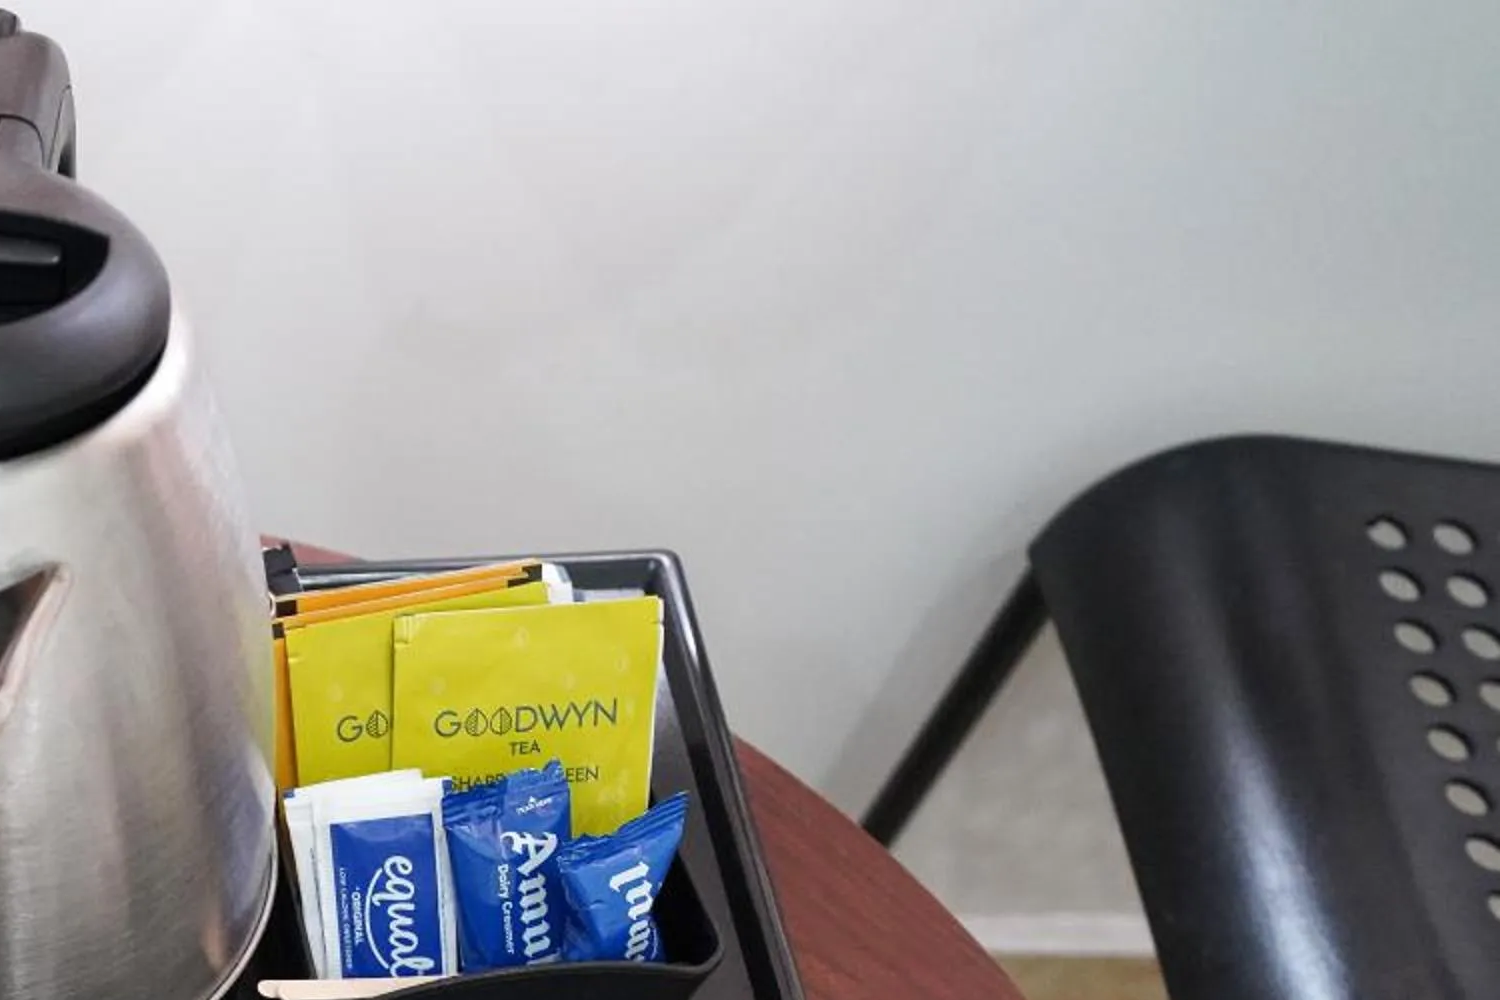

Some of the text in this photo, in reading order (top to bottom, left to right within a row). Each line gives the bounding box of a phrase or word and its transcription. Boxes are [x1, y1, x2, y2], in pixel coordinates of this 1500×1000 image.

[433, 698, 619, 738] GOODWYN
[508, 739, 541, 757] TEA
[371, 855, 435, 979] equal
